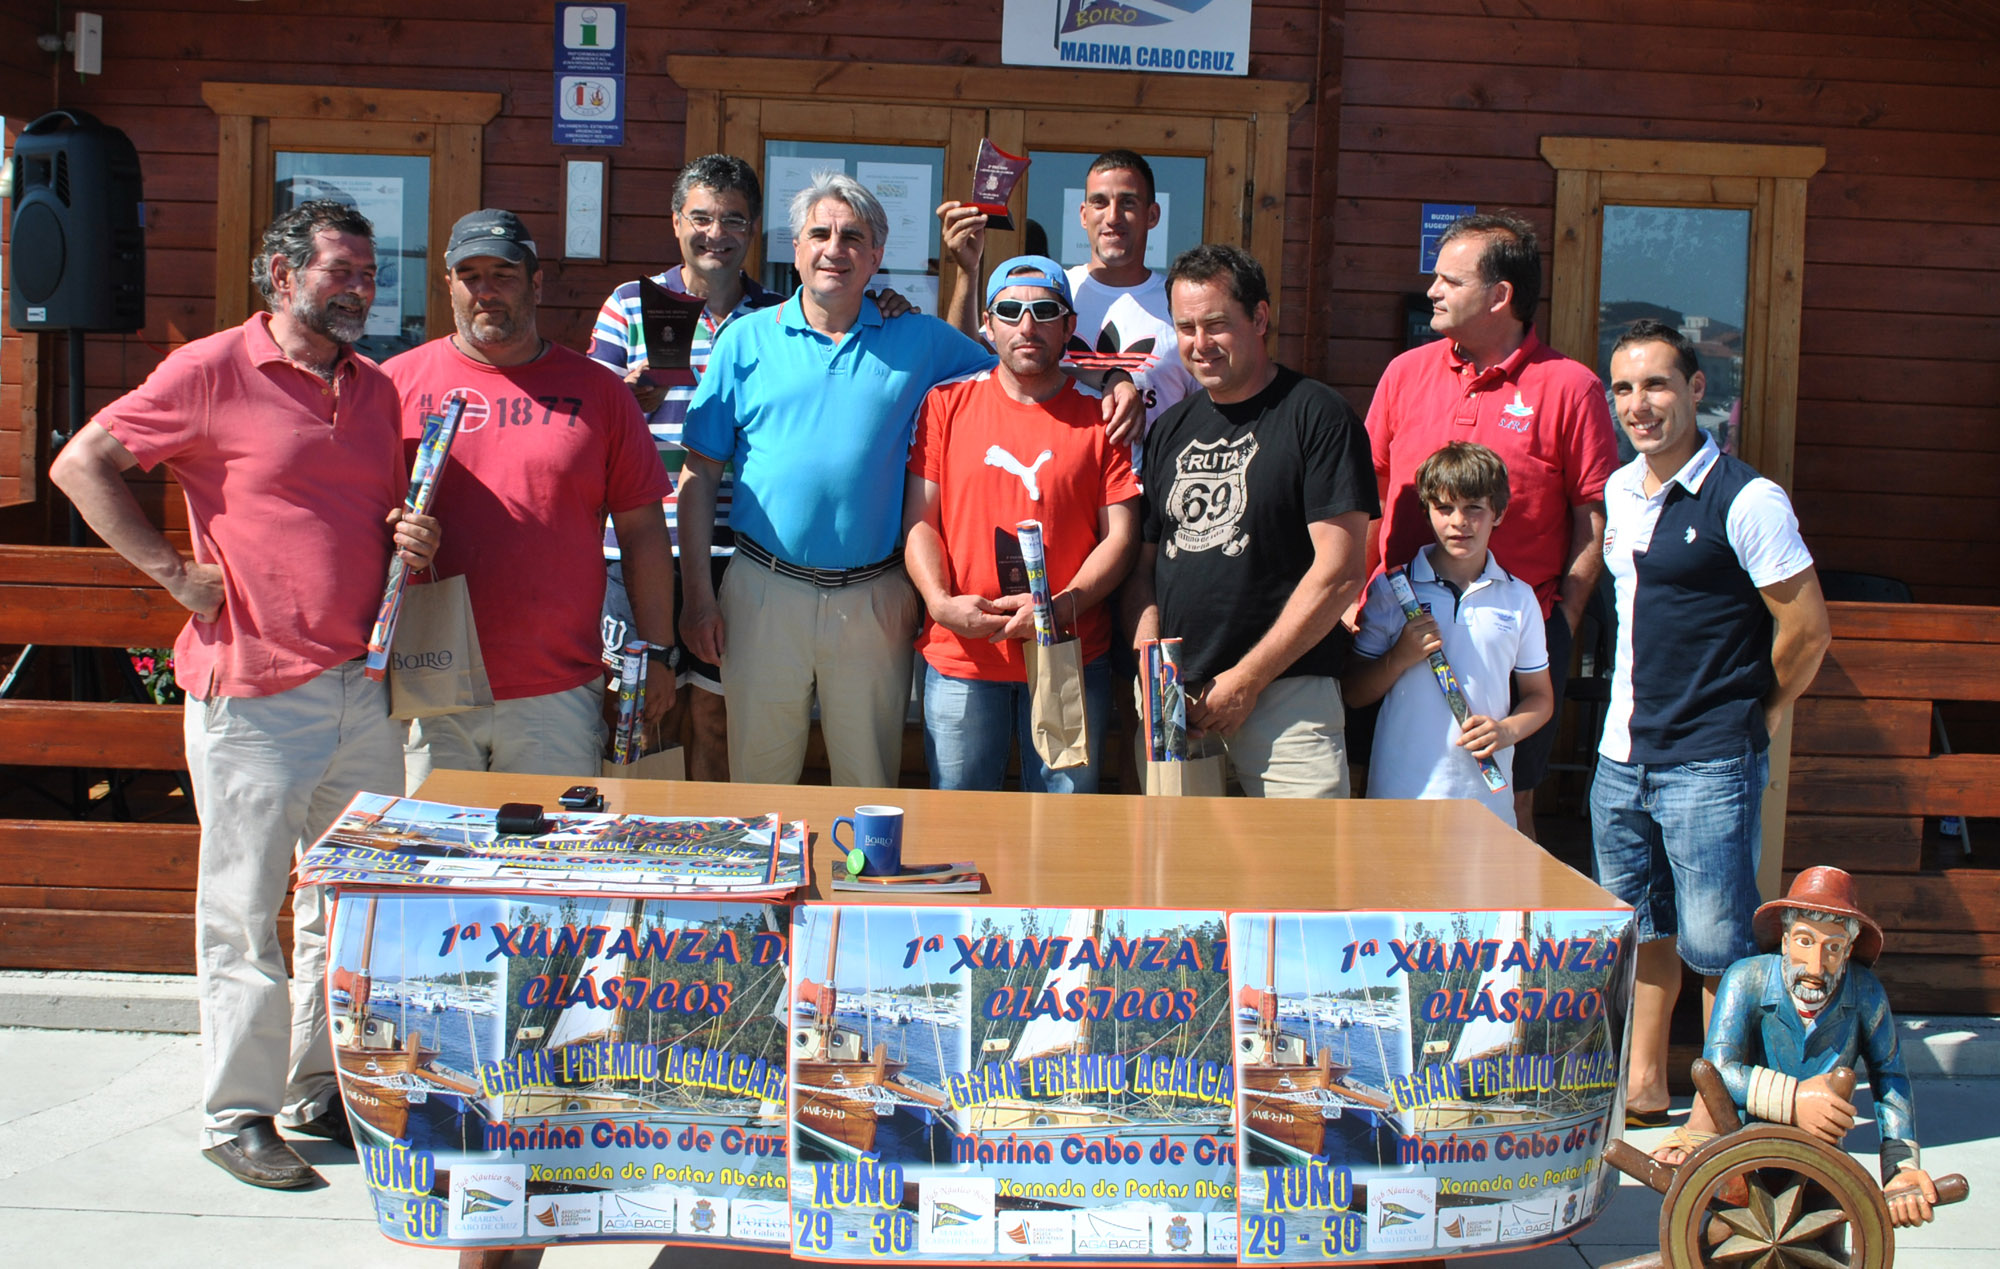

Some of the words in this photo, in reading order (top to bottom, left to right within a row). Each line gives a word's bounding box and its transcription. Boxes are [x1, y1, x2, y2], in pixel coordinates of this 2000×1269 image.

[1075, 9, 1138, 27] BOIRO
[1060, 41, 1132, 66] MARINA
[1136, 47, 1183, 69] CABO
[1187, 50, 1235, 71] CRUZ
[496, 396, 583, 428] 1877
[1187, 449, 1240, 471] RUTA
[1181, 481, 1231, 523] 69
[566, 856, 642, 866] Cabo
[439, 922, 481, 957] 1ª
[486, 922, 742, 965] XUNTANZA
[751, 931, 789, 967] D
[903, 934, 944, 968] 1ª
[949, 936, 1204, 974] XUNTANZA
[1341, 938, 1380, 973] 1ª
[517, 966, 734, 1016] CLÁSICOS
[981, 977, 1198, 1022] CLÁSICOS
[1421, 979, 1604, 1024] CLÁSICO
[481, 1048, 556, 1099] GRAN
[563, 1041, 658, 1083] PREMIO
[947, 1060, 1022, 1111] GRAN
[1029, 1052, 1127, 1097] PREMIO
[1135, 1054, 1237, 1108] AGALCA
[1392, 1062, 1463, 1113] GRAN
[1469, 1054, 1555, 1097] PREMIO
[483, 1119, 585, 1151] Marina
[591, 1118, 671, 1150] Cabo
[677, 1123, 715, 1153] de
[720, 1125, 788, 1158] Cruz
[952, 1132, 1054, 1165] Marina
[1060, 1134, 1144, 1166] Cabo
[1149, 1135, 1188, 1166] de
[1193, 1134, 1237, 1166] Cru
[1397, 1132, 1489, 1165] Marina
[1494, 1130, 1561, 1162] Cabo
[1563, 1125, 1587, 1154] de
[528, 1162, 614, 1183] Xornada
[620, 1162, 647, 1181] de
[653, 1163, 714, 1185] Portas
[720, 1167, 788, 1189] Aberta
[812, 1150, 905, 1210] XUÑO
[998, 1178, 1086, 1198] Xornada
[1092, 1179, 1120, 1199] de
[1125, 1179, 1190, 1199] Portas
[1263, 1154, 1353, 1213] XUÑO
[1440, 1174, 1514, 1195] Xornada
[1518, 1172, 1539, 1190] de
[1543, 1165, 1582, 1187] Portas
[403, 1198, 444, 1241] 30
[604, 1219, 673, 1229] AGABACE
[795, 1208, 833, 1253] 29
[870, 1211, 913, 1256] 30
[1245, 1214, 1286, 1258] 29
[1321, 1213, 1362, 1257] 30
[1078, 1239, 1147, 1249] AGABACE
